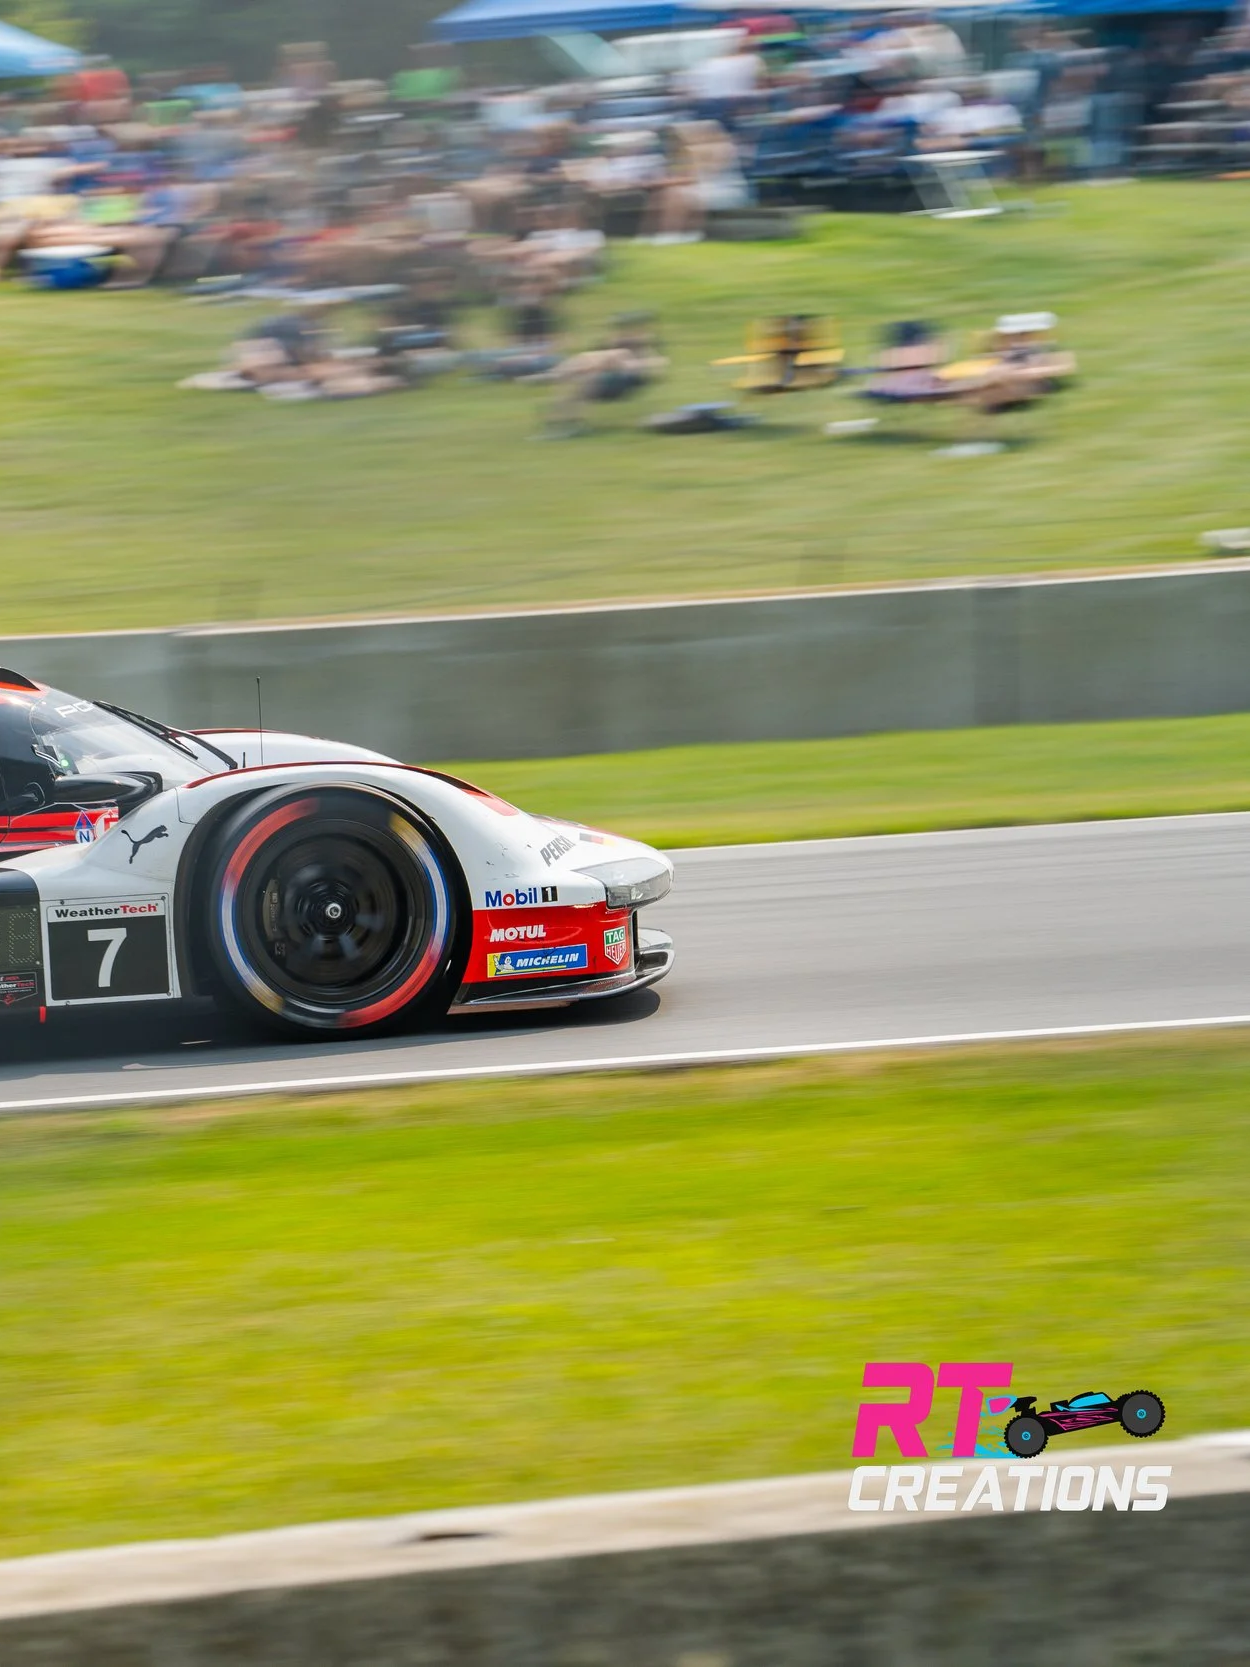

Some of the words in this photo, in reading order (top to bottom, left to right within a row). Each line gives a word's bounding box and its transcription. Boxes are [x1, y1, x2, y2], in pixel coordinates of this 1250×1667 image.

[78, 829, 91, 844] N
[485, 887, 537, 907] Mobil
[54, 903, 159, 919] WeatherTech
[489, 924, 547, 943] MOTUL
[606, 928, 625, 943] TAG
[87, 927, 128, 988] 7
[515, 952, 580, 968] MICHELIN
[606, 942, 627, 962] HEUER
